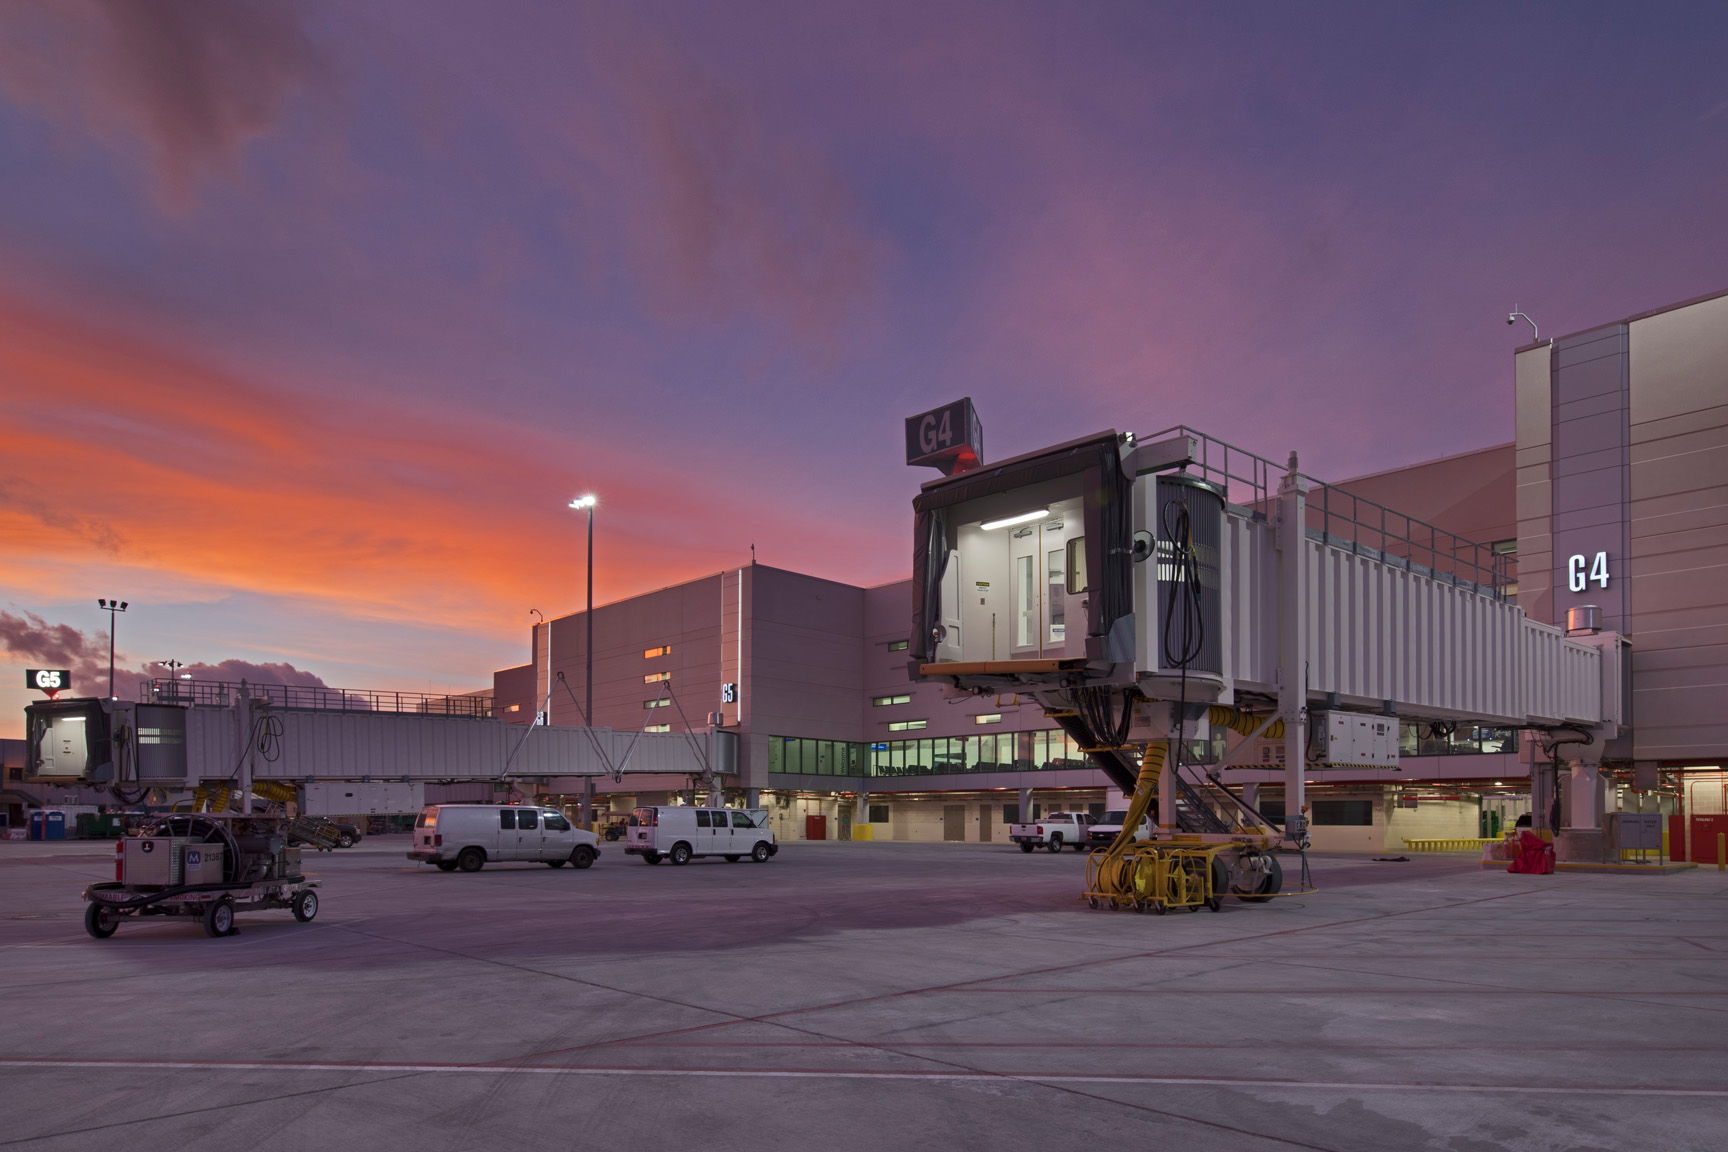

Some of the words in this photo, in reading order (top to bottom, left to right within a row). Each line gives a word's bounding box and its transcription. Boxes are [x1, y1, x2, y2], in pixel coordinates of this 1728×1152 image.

[919, 410, 952, 453] G4
[1568, 551, 1610, 592] G4
[36, 670, 61, 688] G5
[722, 683, 733, 703] G5
[188, 853, 200, 862] M
[204, 853, 223, 862] 21387
